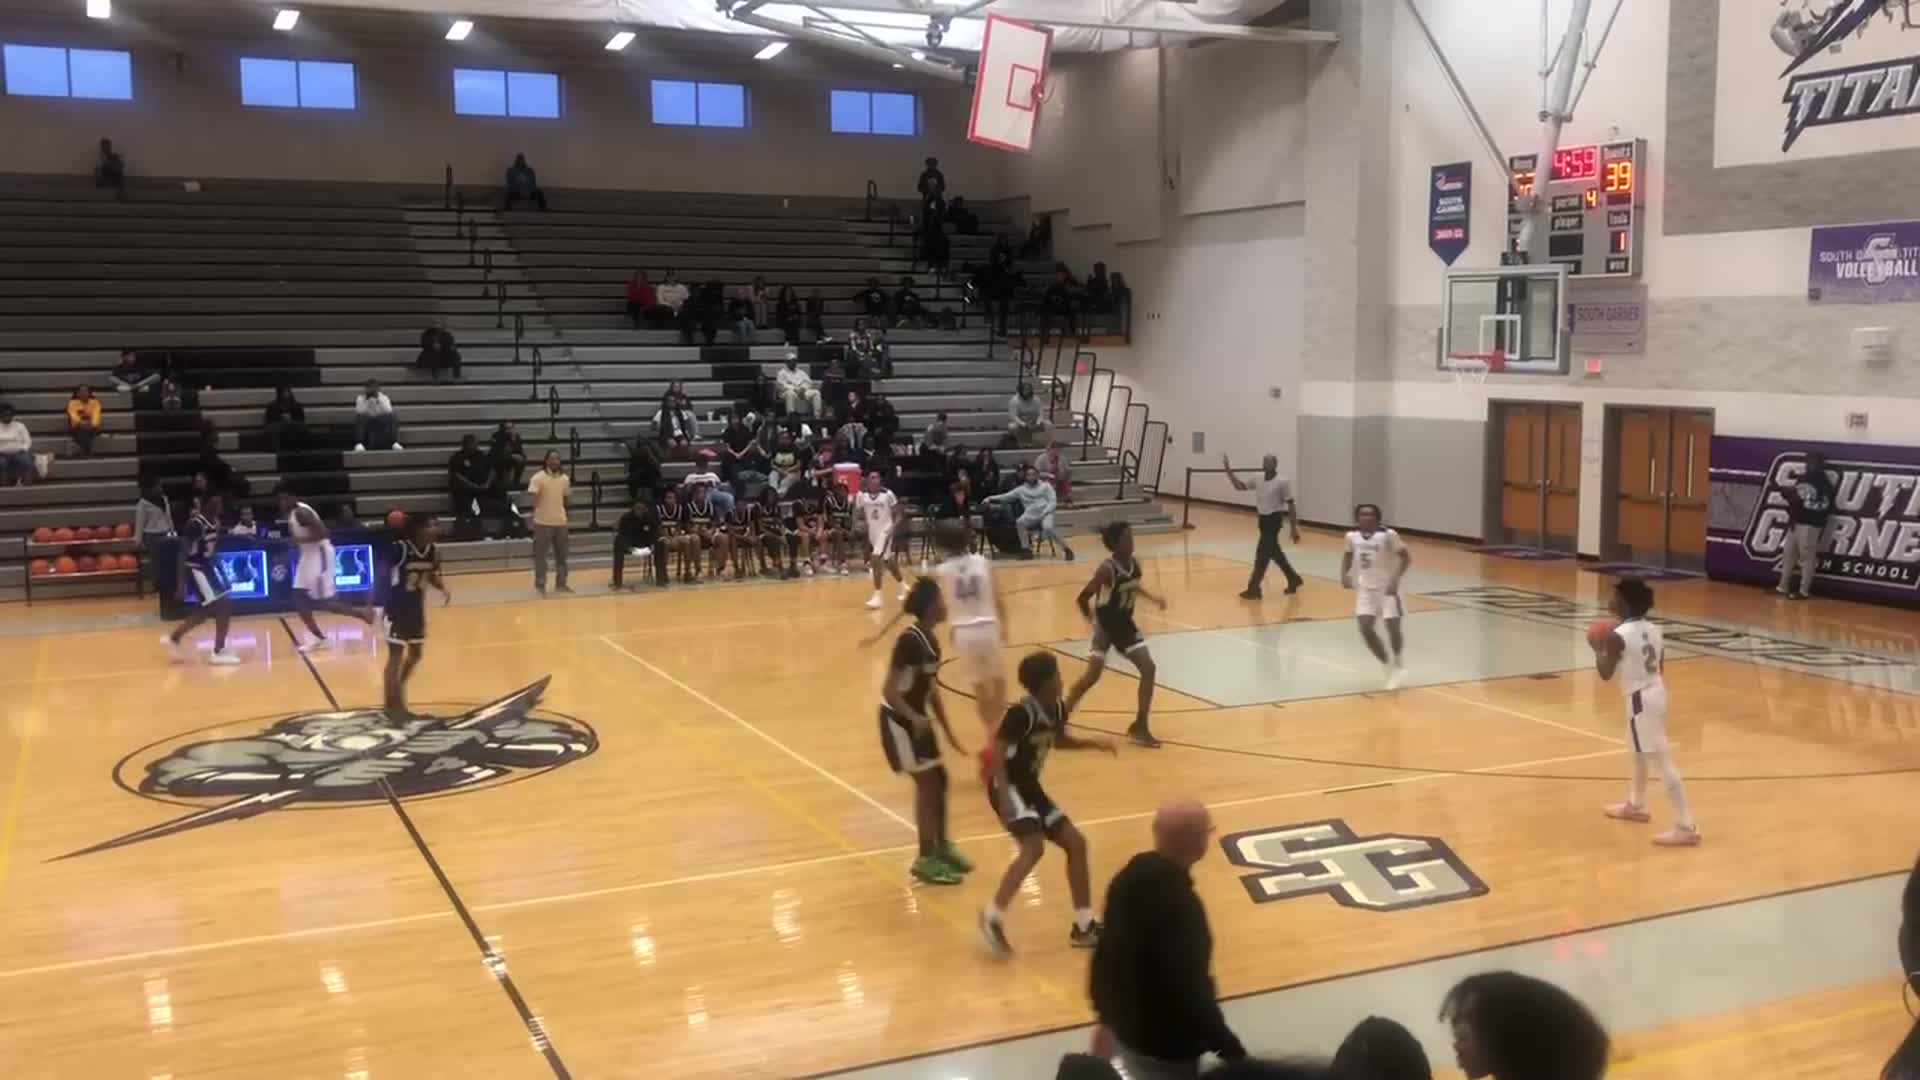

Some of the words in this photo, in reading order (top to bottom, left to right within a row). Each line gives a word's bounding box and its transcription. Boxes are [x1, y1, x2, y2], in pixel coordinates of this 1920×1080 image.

[1783, 57, 1920, 130] TITA
[1554, 149, 1596, 177] 4:59
[1606, 161, 1632, 191] 39
[1586, 190, 1597, 208] 4
[1819, 250, 1853, 263] SOUTH
[1360, 552, 1372, 570] 5
[1841, 560, 1910, 580] SCHOOL
[1641, 642, 1658, 675] 2
